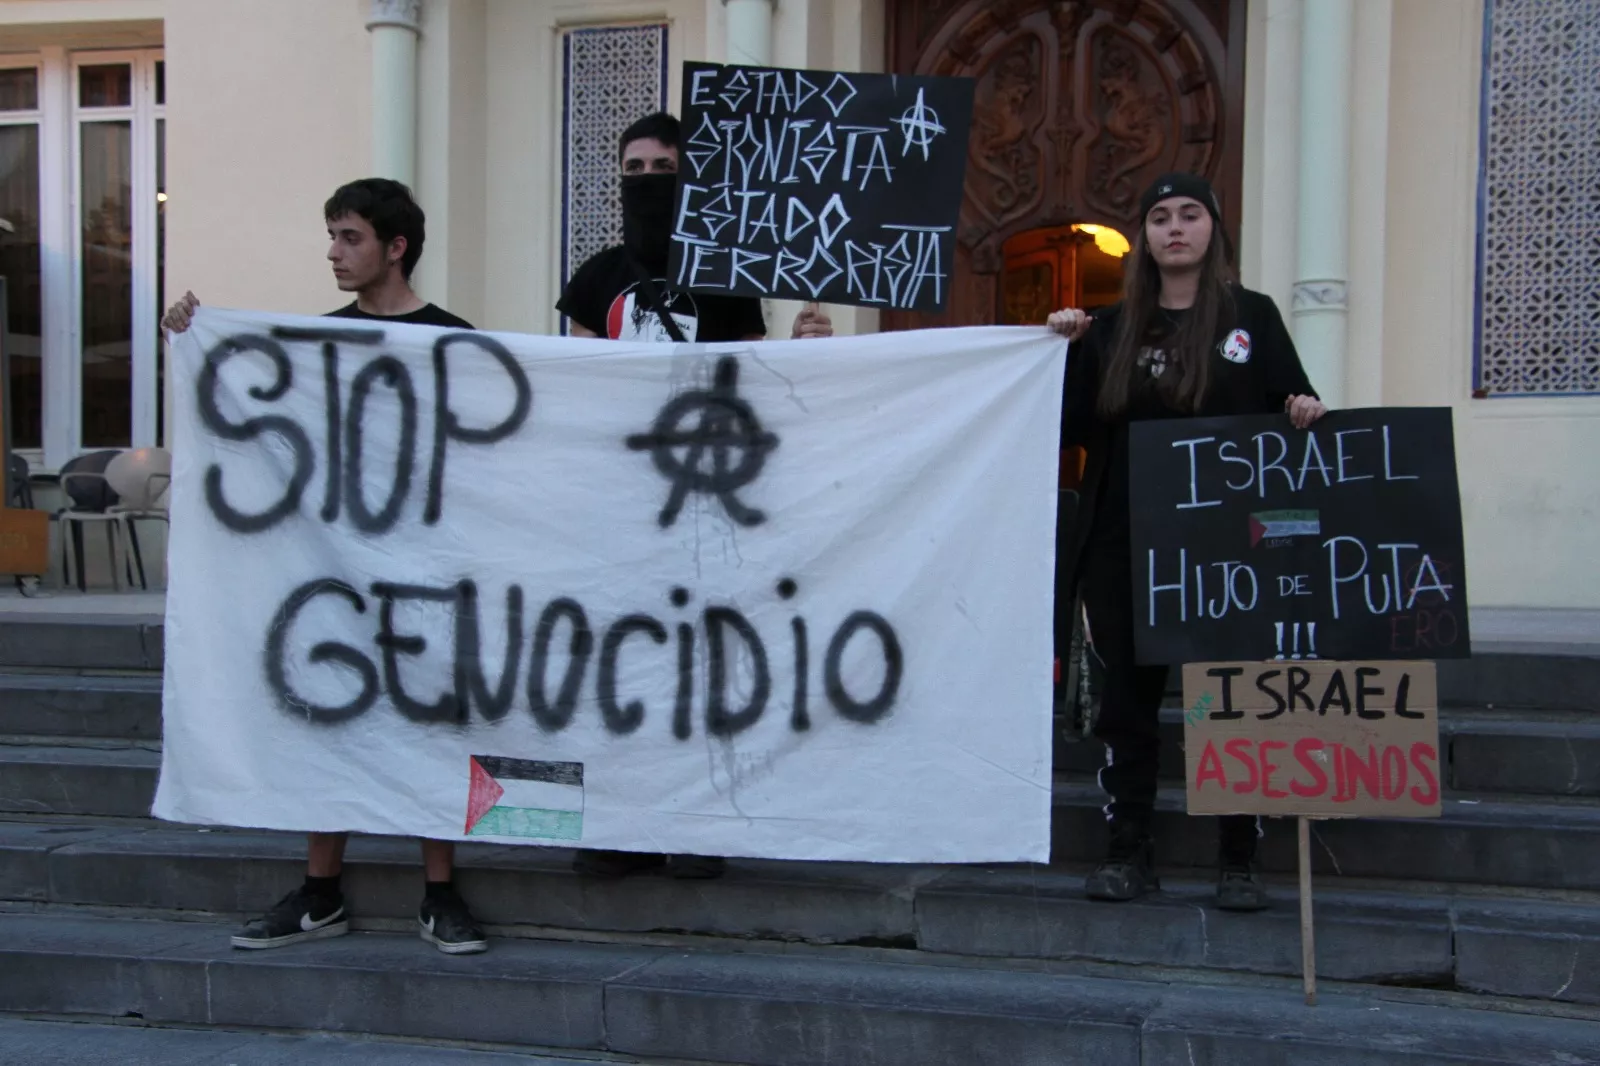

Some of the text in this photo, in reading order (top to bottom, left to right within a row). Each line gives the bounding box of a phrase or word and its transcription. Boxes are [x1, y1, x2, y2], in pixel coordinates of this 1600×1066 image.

[691, 70, 857, 117] ESTADO
[686, 112, 896, 191] SIONISTA
[676, 184, 851, 248] ESTADO
[671, 224, 952, 308] TERRORISTA
[197, 325, 532, 535] STOP
[1149, 548, 1258, 626] HIJO
[1276, 575, 1313, 596] DE
[1206, 666, 1425, 721] ISRAEL
[1195, 737, 1439, 806] ASESINOS
